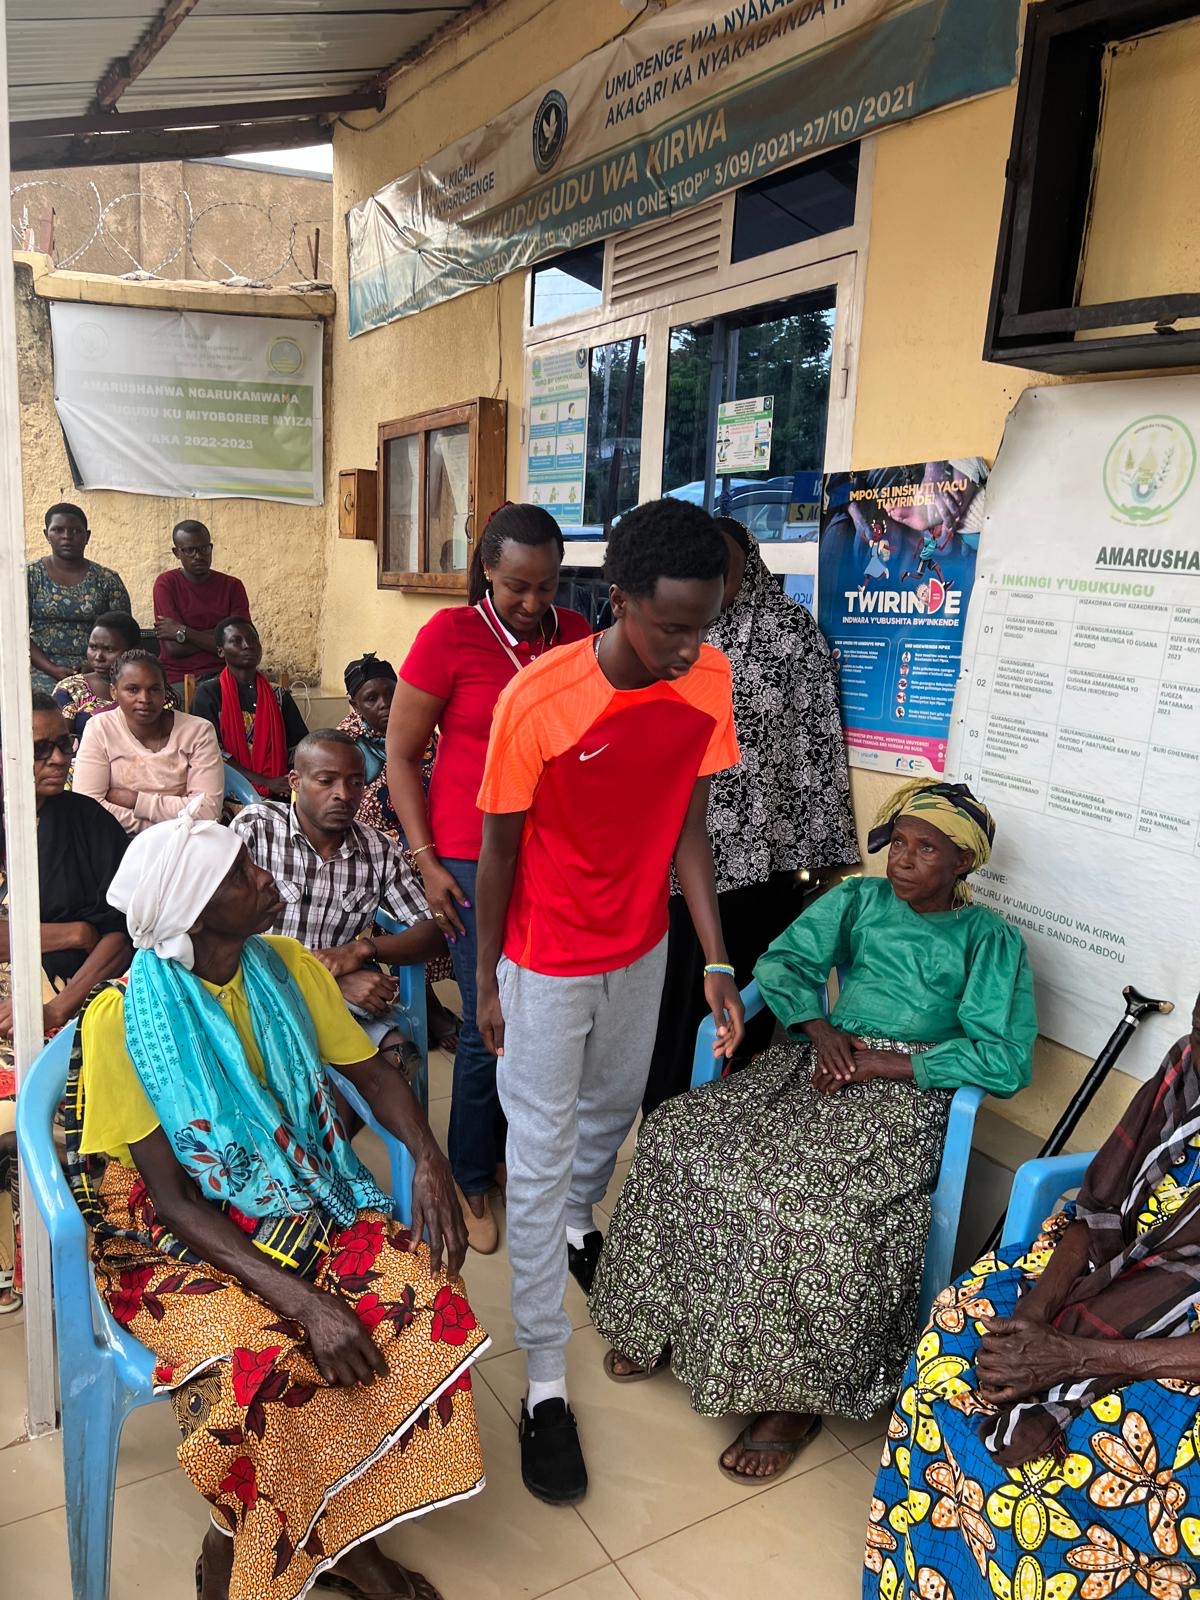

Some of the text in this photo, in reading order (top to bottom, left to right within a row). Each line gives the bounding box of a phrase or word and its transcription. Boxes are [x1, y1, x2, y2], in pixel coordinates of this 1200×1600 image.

[605, 0, 794, 100] UMURENGE WA NYAKA
[605, 1, 825, 128] AKAGARI KA NYAKABANDA
[602, 158, 640, 195] WA
[648, 108, 727, 178] KIRWA
[636, 189, 668, 216] ONE
[714, 81, 916, 187] 3/09/2021-27/10/2021
[449, 159, 478, 188] KIGALI
[163, 408, 182, 420] KU
[185, 410, 269, 425] MIYOBORERE
[272, 415, 313, 429] MYIZA
[184, 435, 254, 449] 2022-2023
[850, 479, 968, 501] MPOX SI INSHUTI YACU
[877, 494, 935, 509] TUYIRINDE!
[844, 578, 962, 614] TWIRINDE
[1002, 574, 1052, 588] INKINGI
[1056, 578, 1155, 597] Y'UBUKUNGU
[842, 616, 870, 624] INDWARA
[871, 616, 912, 625] Y'UBUSHITA
[984, 626, 995, 634] 01
[976, 679, 987, 687] 02
[969, 730, 979, 738] 03
[964, 773, 973, 781] 04
[1003, 895, 1073, 927] W'UMUDUGUDU
[1075, 920, 1091, 934] WA
[1093, 927, 1126, 946] KIRWA
[1006, 913, 1126, 964] AIMABLE SANDRO ABDOU
